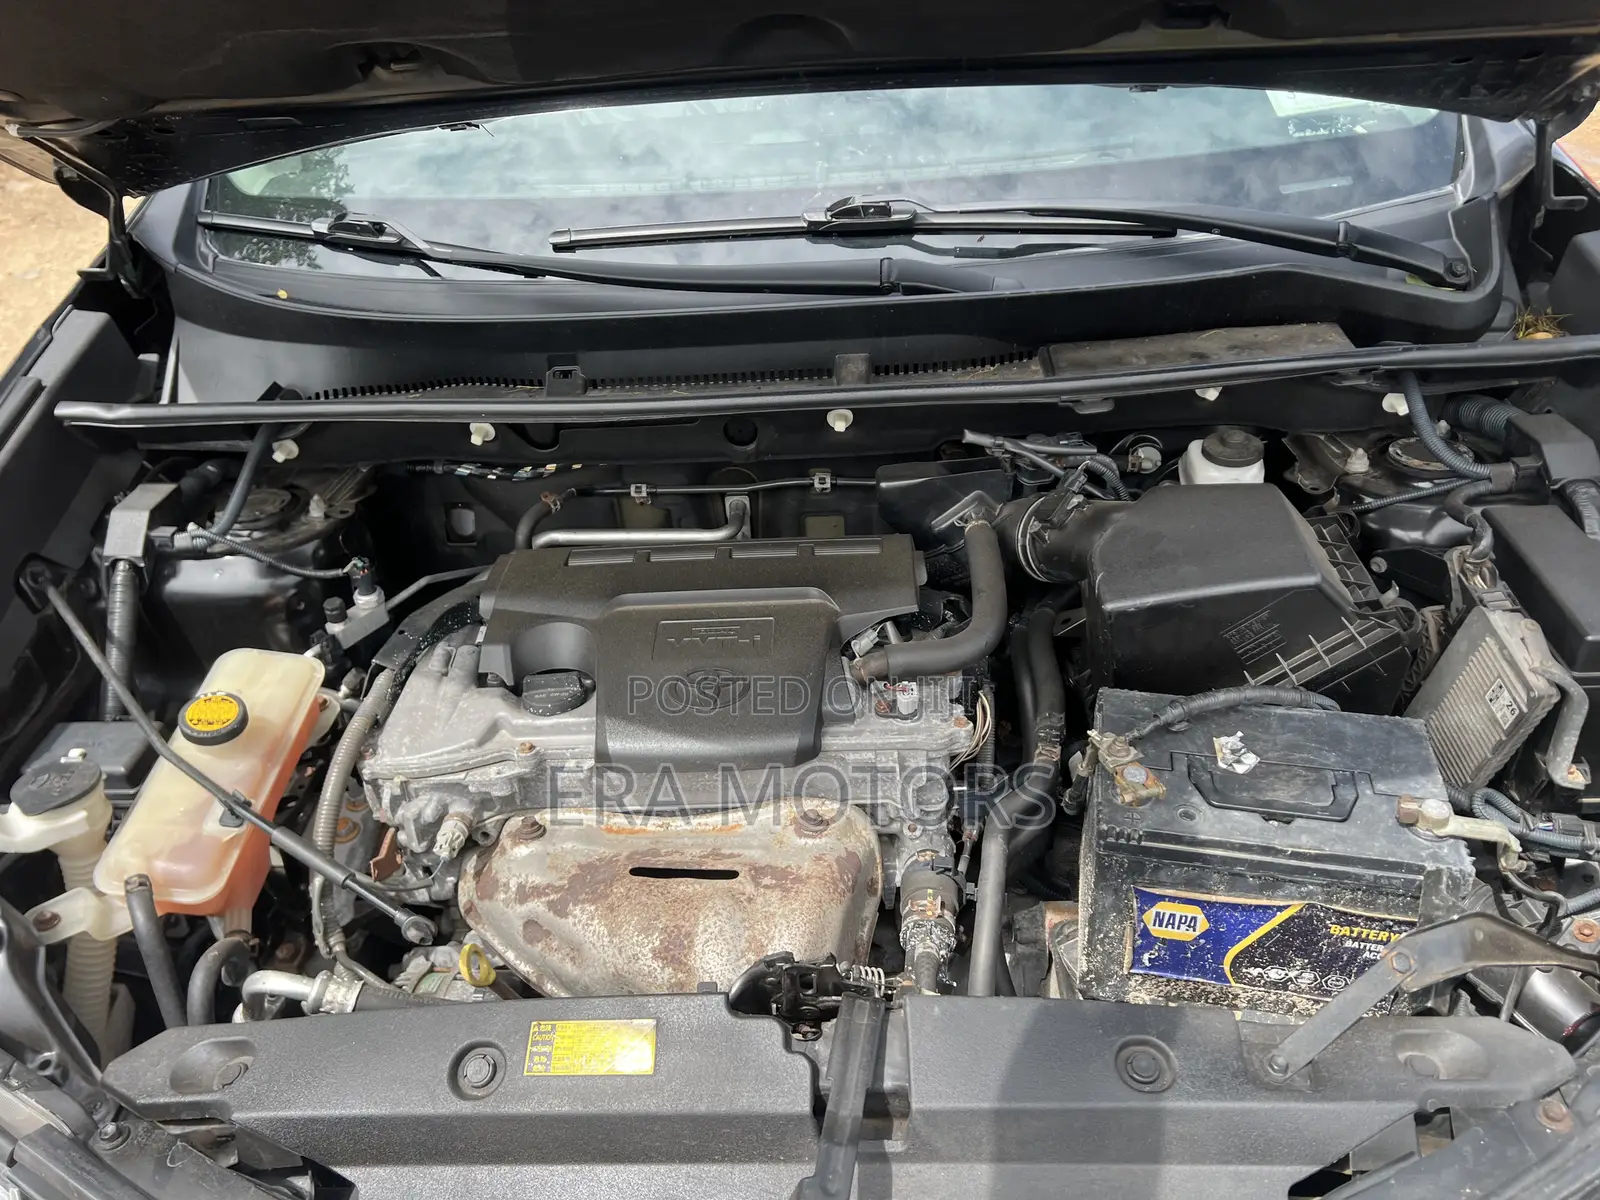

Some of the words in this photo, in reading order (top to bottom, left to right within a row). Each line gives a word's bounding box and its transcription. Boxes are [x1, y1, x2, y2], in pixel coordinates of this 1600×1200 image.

[1505, 700, 1517, 716] 26
[1152, 910, 1199, 933] NAPA
[1329, 924, 1401, 942] BATTERY
[1344, 938, 1385, 951] BATTER
[1362, 950, 1383, 960] ACC
